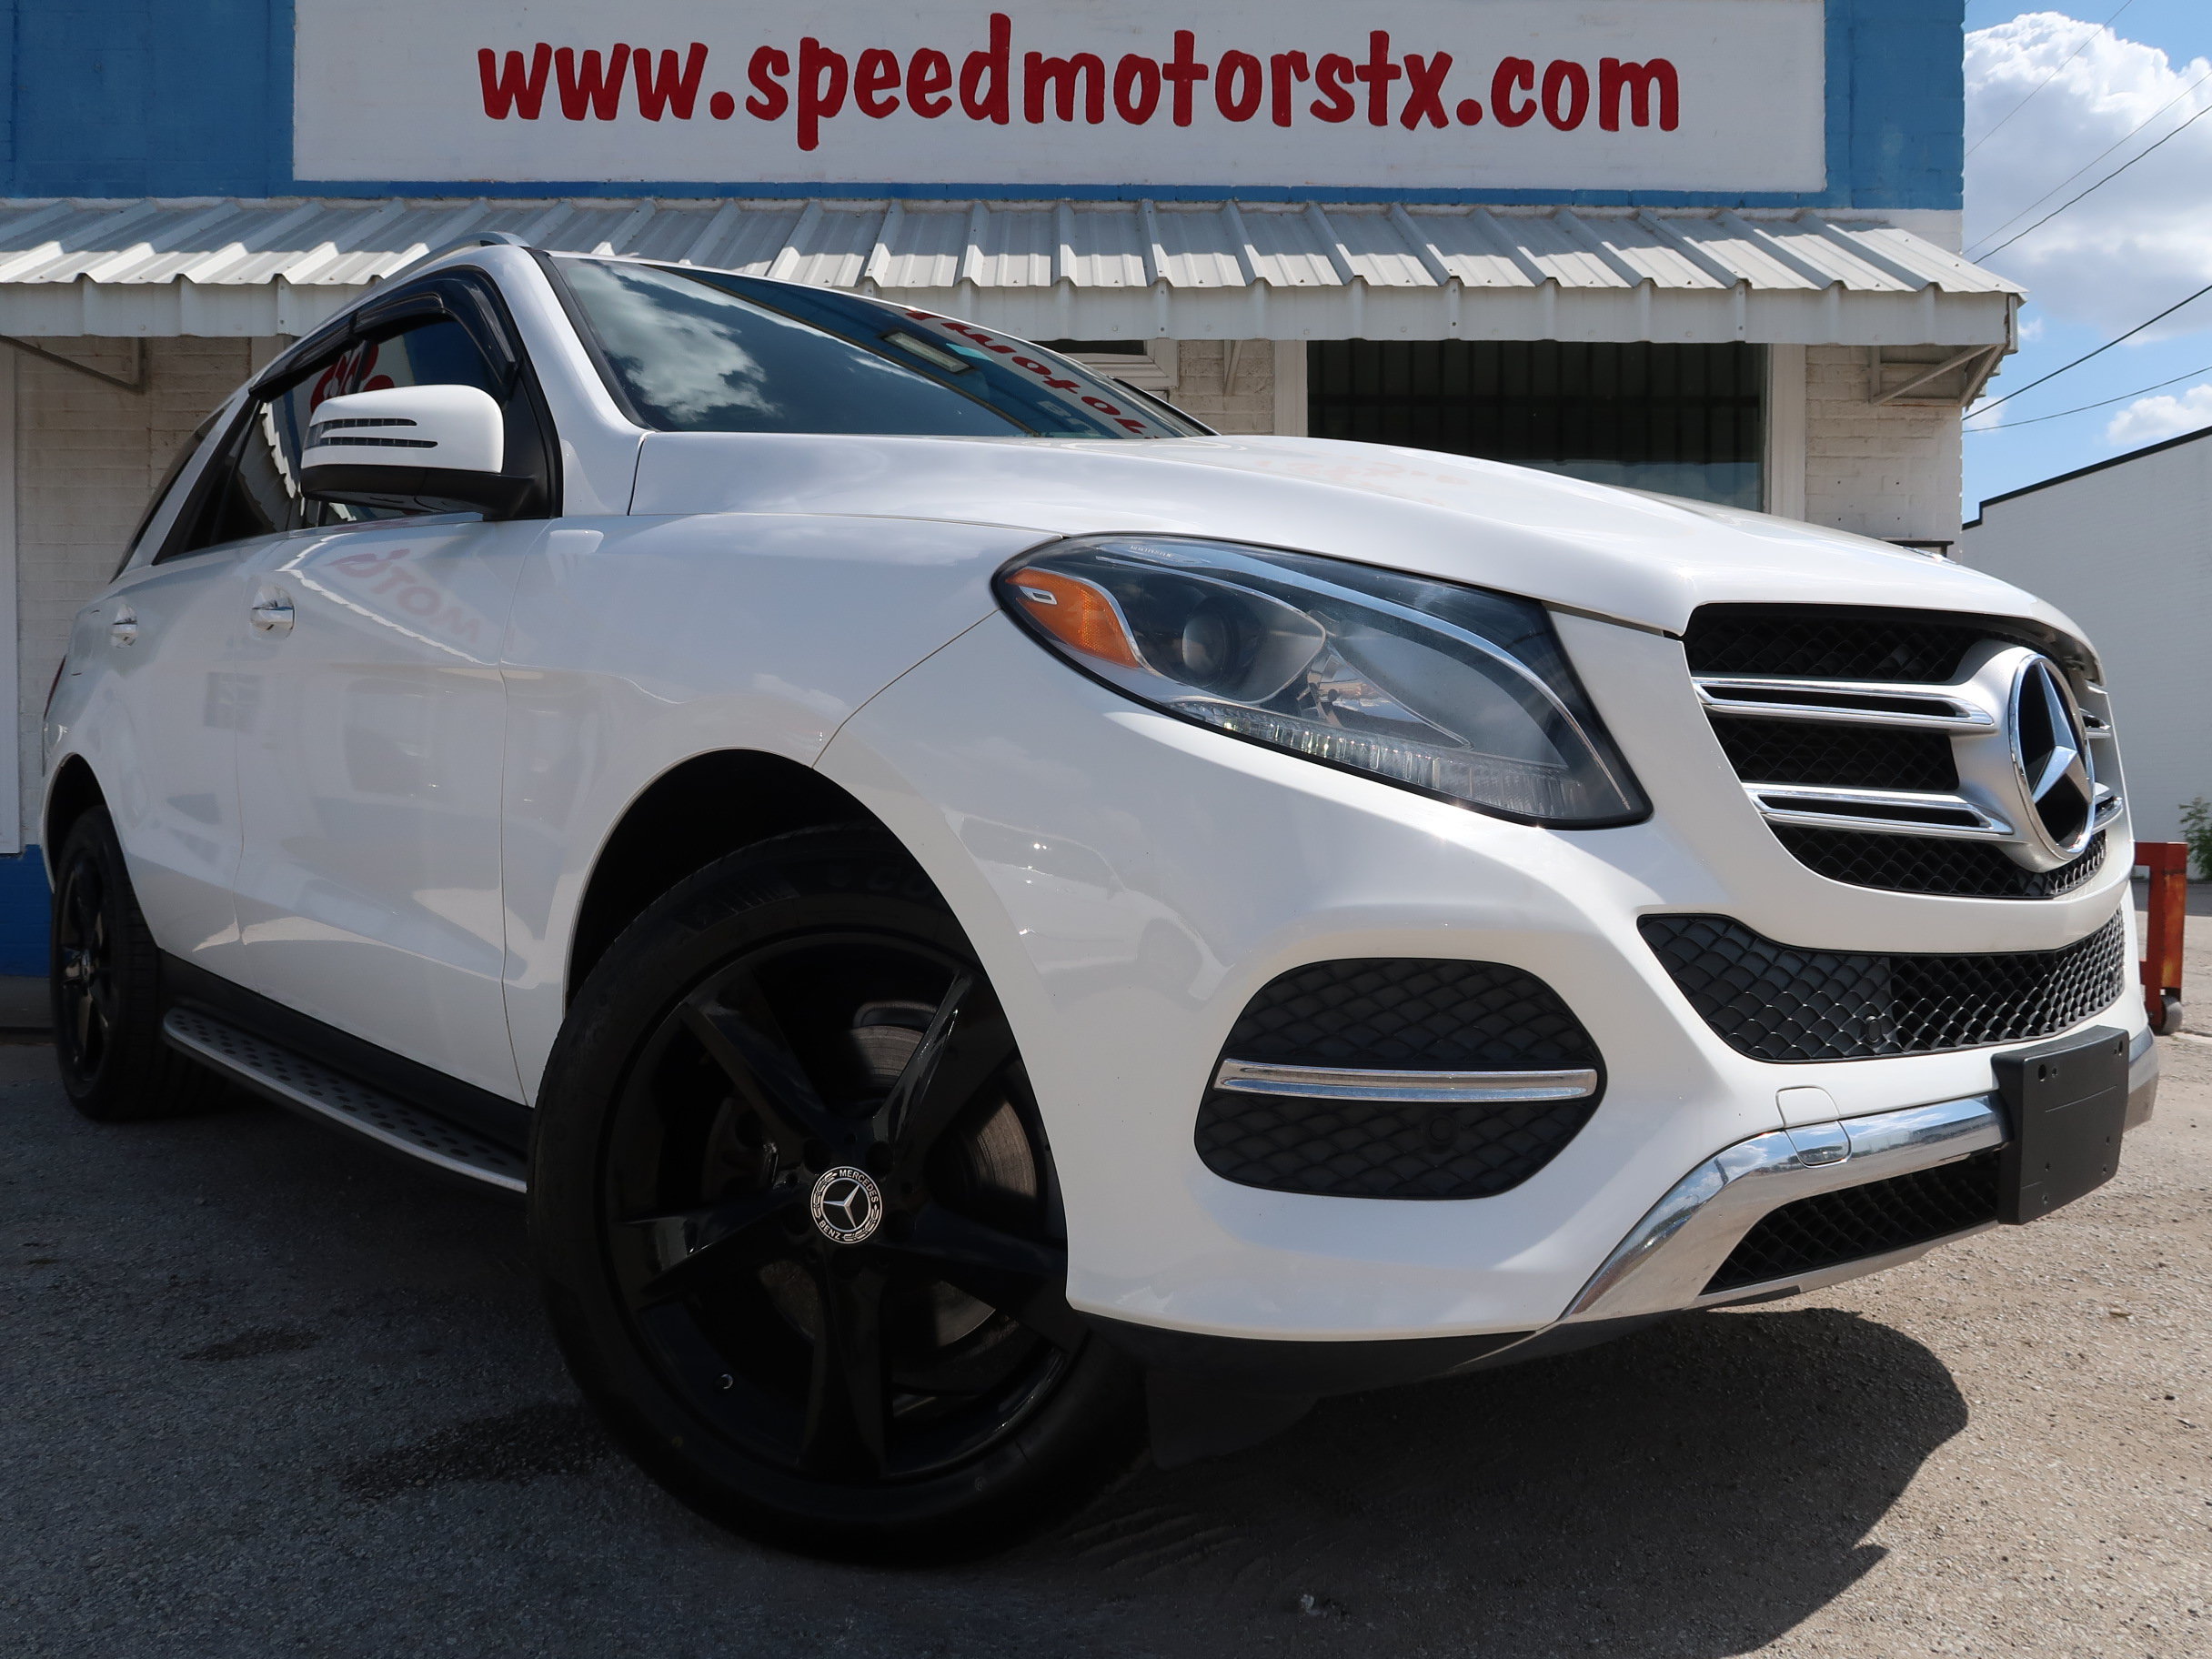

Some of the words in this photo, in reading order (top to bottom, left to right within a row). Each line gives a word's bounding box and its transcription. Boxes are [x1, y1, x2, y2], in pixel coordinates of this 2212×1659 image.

[479, 14, 1677, 150] www.speedmotorstx.com
[840, 1170, 879, 1202] MERCEDES
[819, 1220, 841, 1240] BENZ
